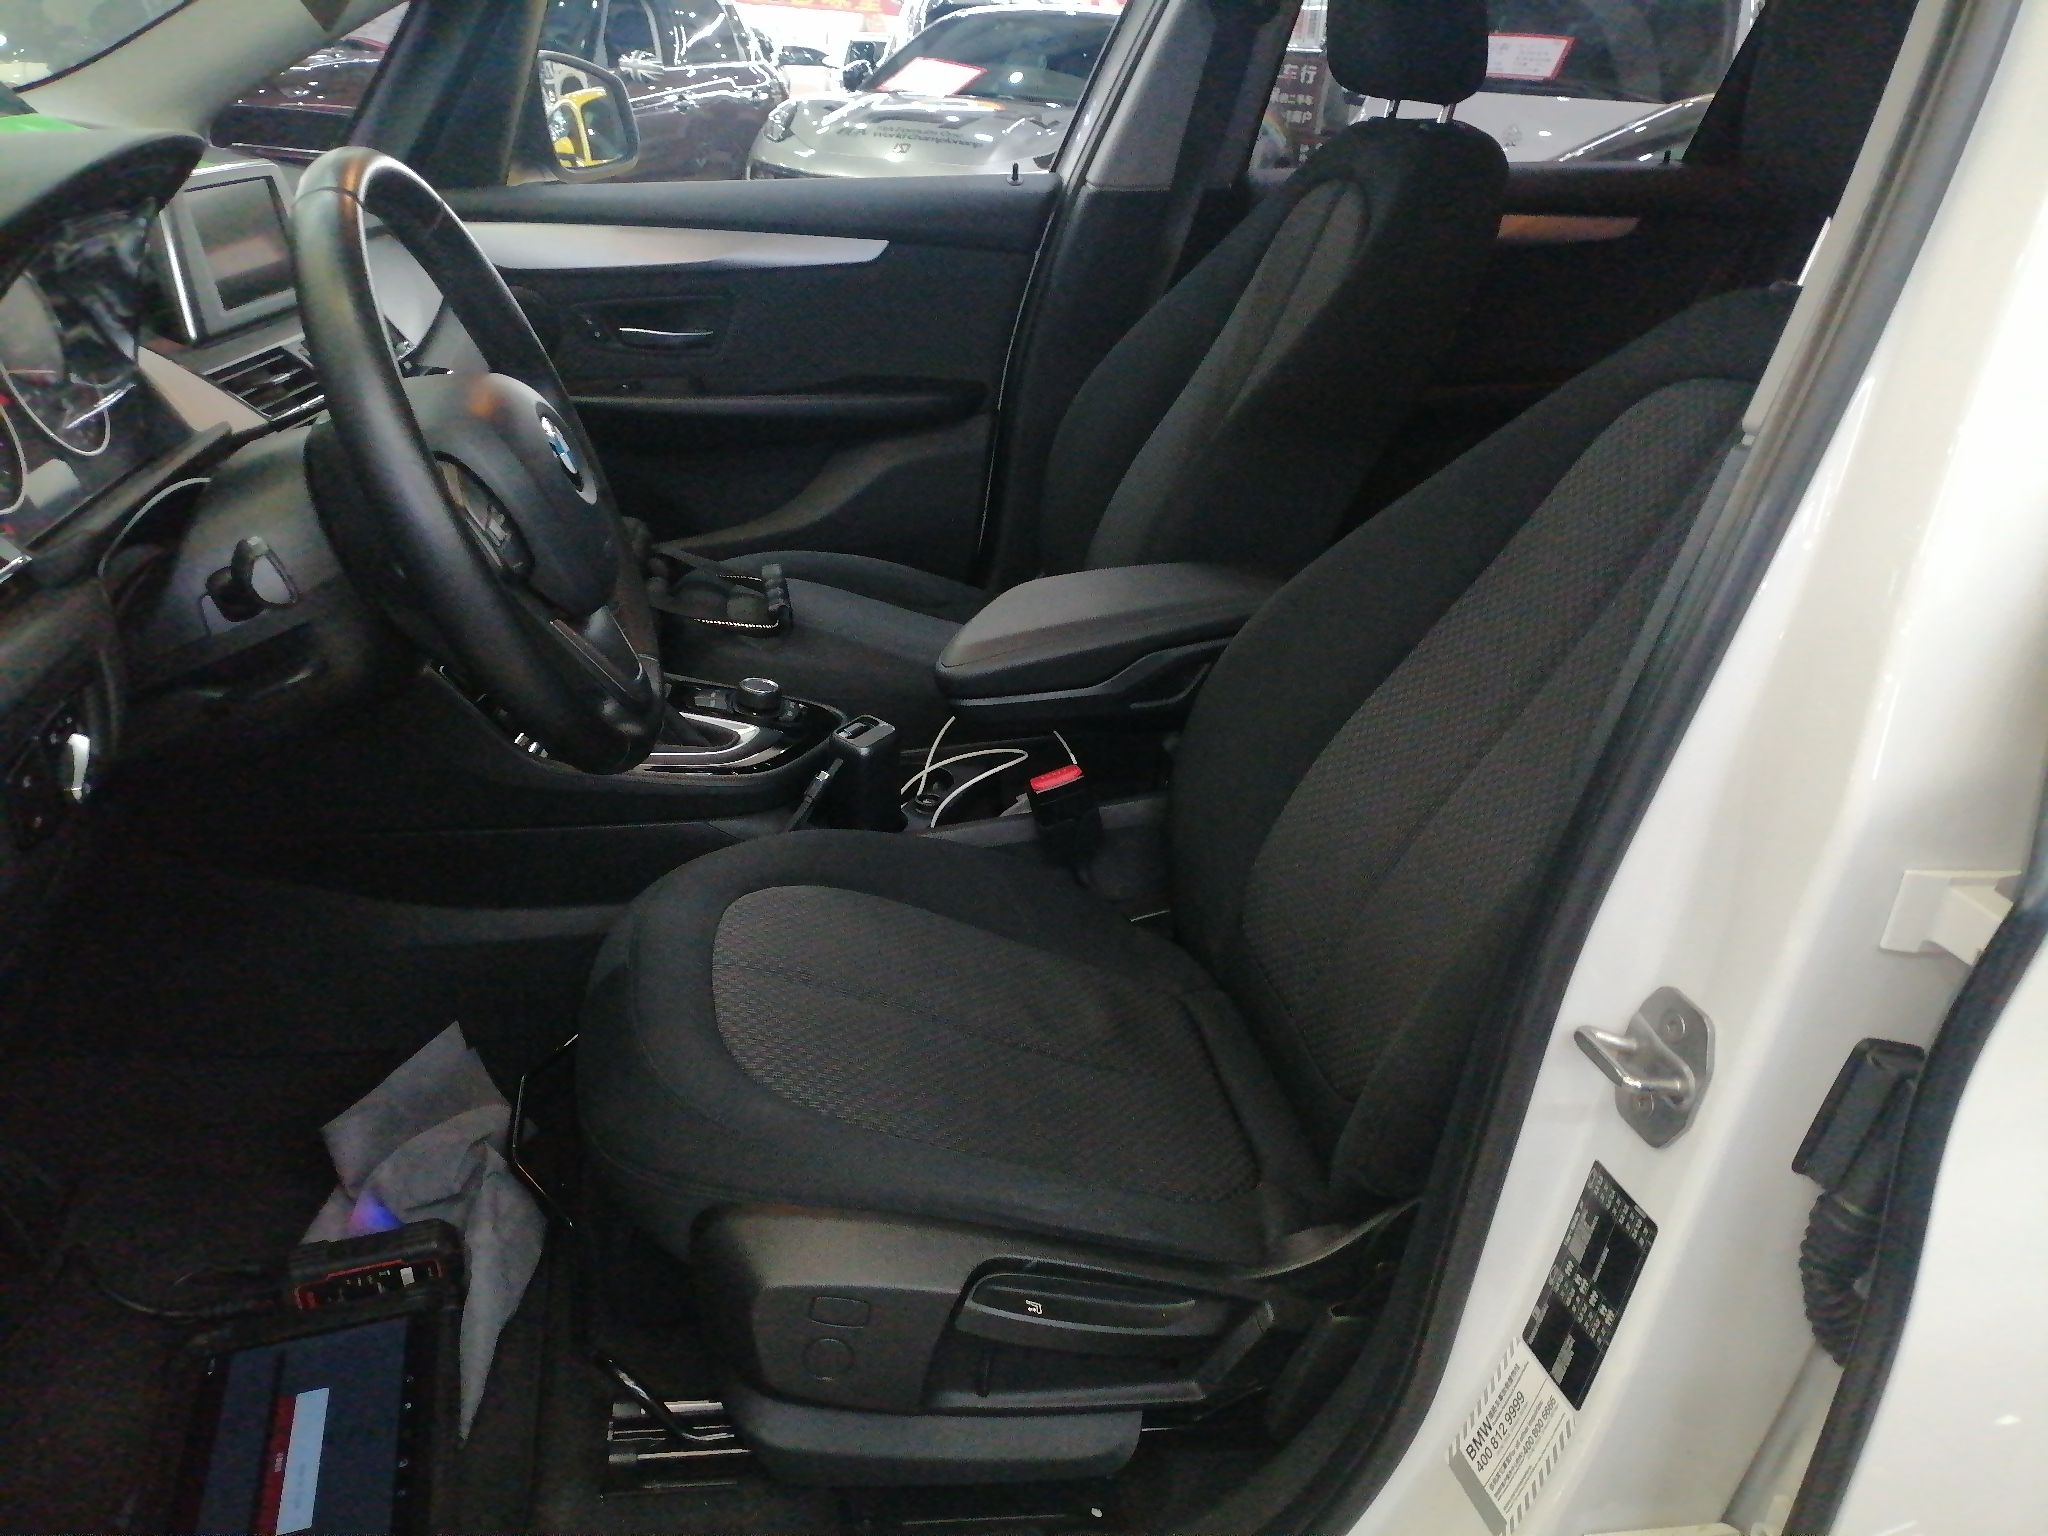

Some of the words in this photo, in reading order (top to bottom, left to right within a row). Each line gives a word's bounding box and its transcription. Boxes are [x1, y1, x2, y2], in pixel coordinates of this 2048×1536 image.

[1466, 1416, 1492, 1461] BMW
[1476, 1447, 1493, 1472] 400
[1490, 1423, 1507, 1449] 812
[1505, 1391, 1525, 1425] 9999
